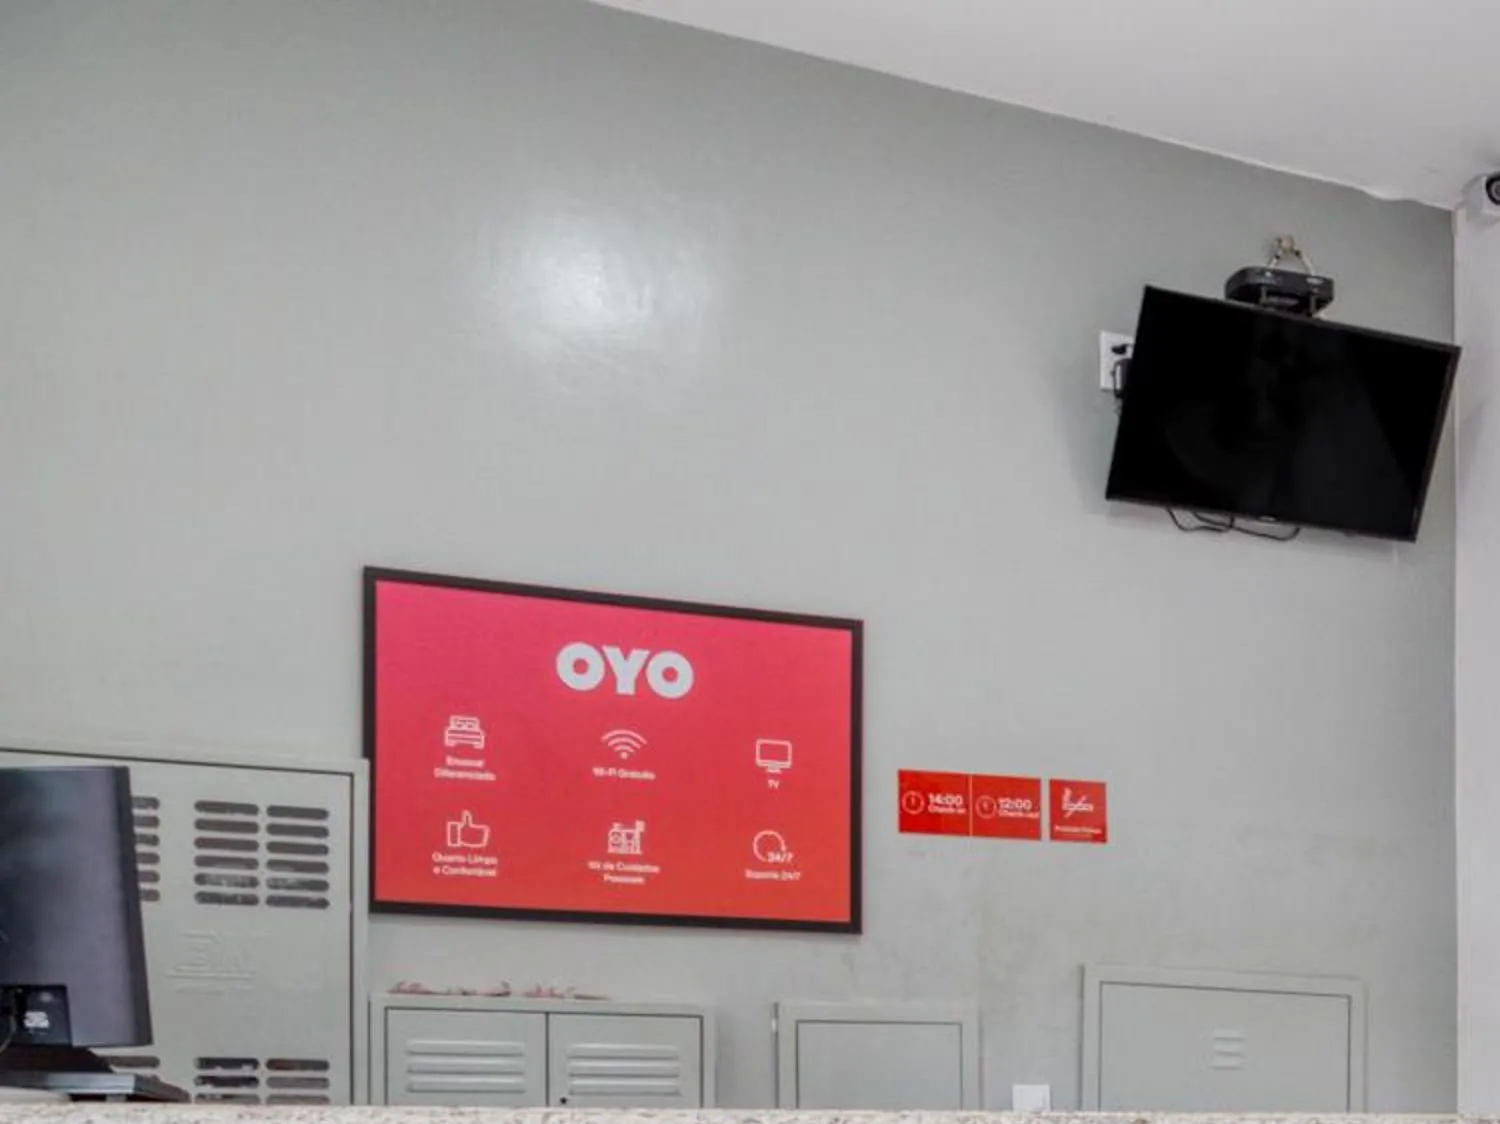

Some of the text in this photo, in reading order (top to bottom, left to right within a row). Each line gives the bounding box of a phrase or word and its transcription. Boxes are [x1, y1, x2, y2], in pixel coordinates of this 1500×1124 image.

[556, 642, 693, 698] OYO
[768, 779, 780, 789] TV
[928, 793, 963, 806] 14:00
[998, 798, 1033, 810] 12:00
